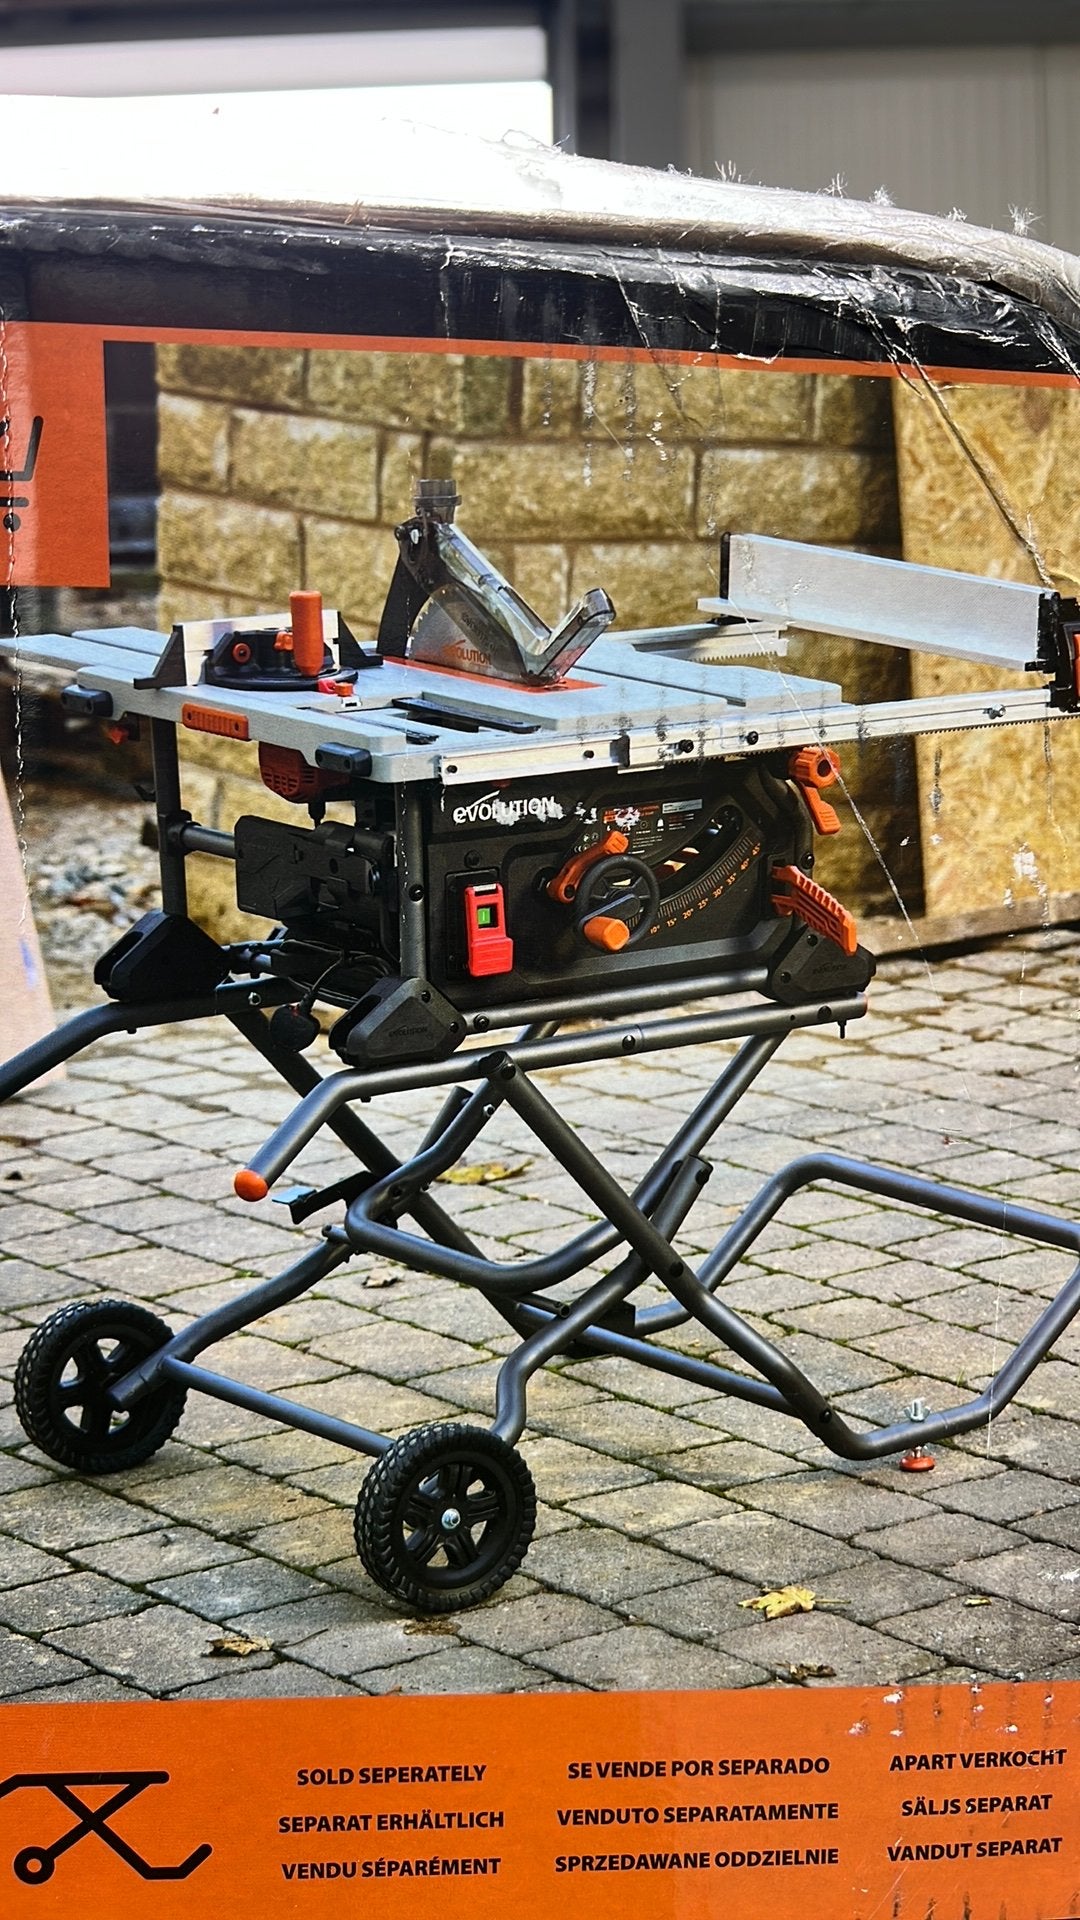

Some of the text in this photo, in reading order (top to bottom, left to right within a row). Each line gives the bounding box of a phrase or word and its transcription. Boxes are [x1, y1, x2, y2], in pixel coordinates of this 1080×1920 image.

[569, 1758, 829, 1779] SE VENDE POR SEPARADO
[890, 1749, 1066, 1771] APART VERKOCHT
[298, 1766, 486, 1785] SOLD SEPERATELY
[557, 1803, 838, 1825] VENDUTO SEPARATAMENTE
[902, 1795, 1052, 1816] SÄLJS SEPARAT
[279, 1810, 503, 1833] SEPARAT ERHÄLTLICH
[556, 1849, 838, 1872] SPRZEDAWANE ODDZIELNIE
[888, 1838, 1062, 1861] VANDUT SEPARAT
[282, 1857, 501, 1879] VENDU SÉPARÉMENT
